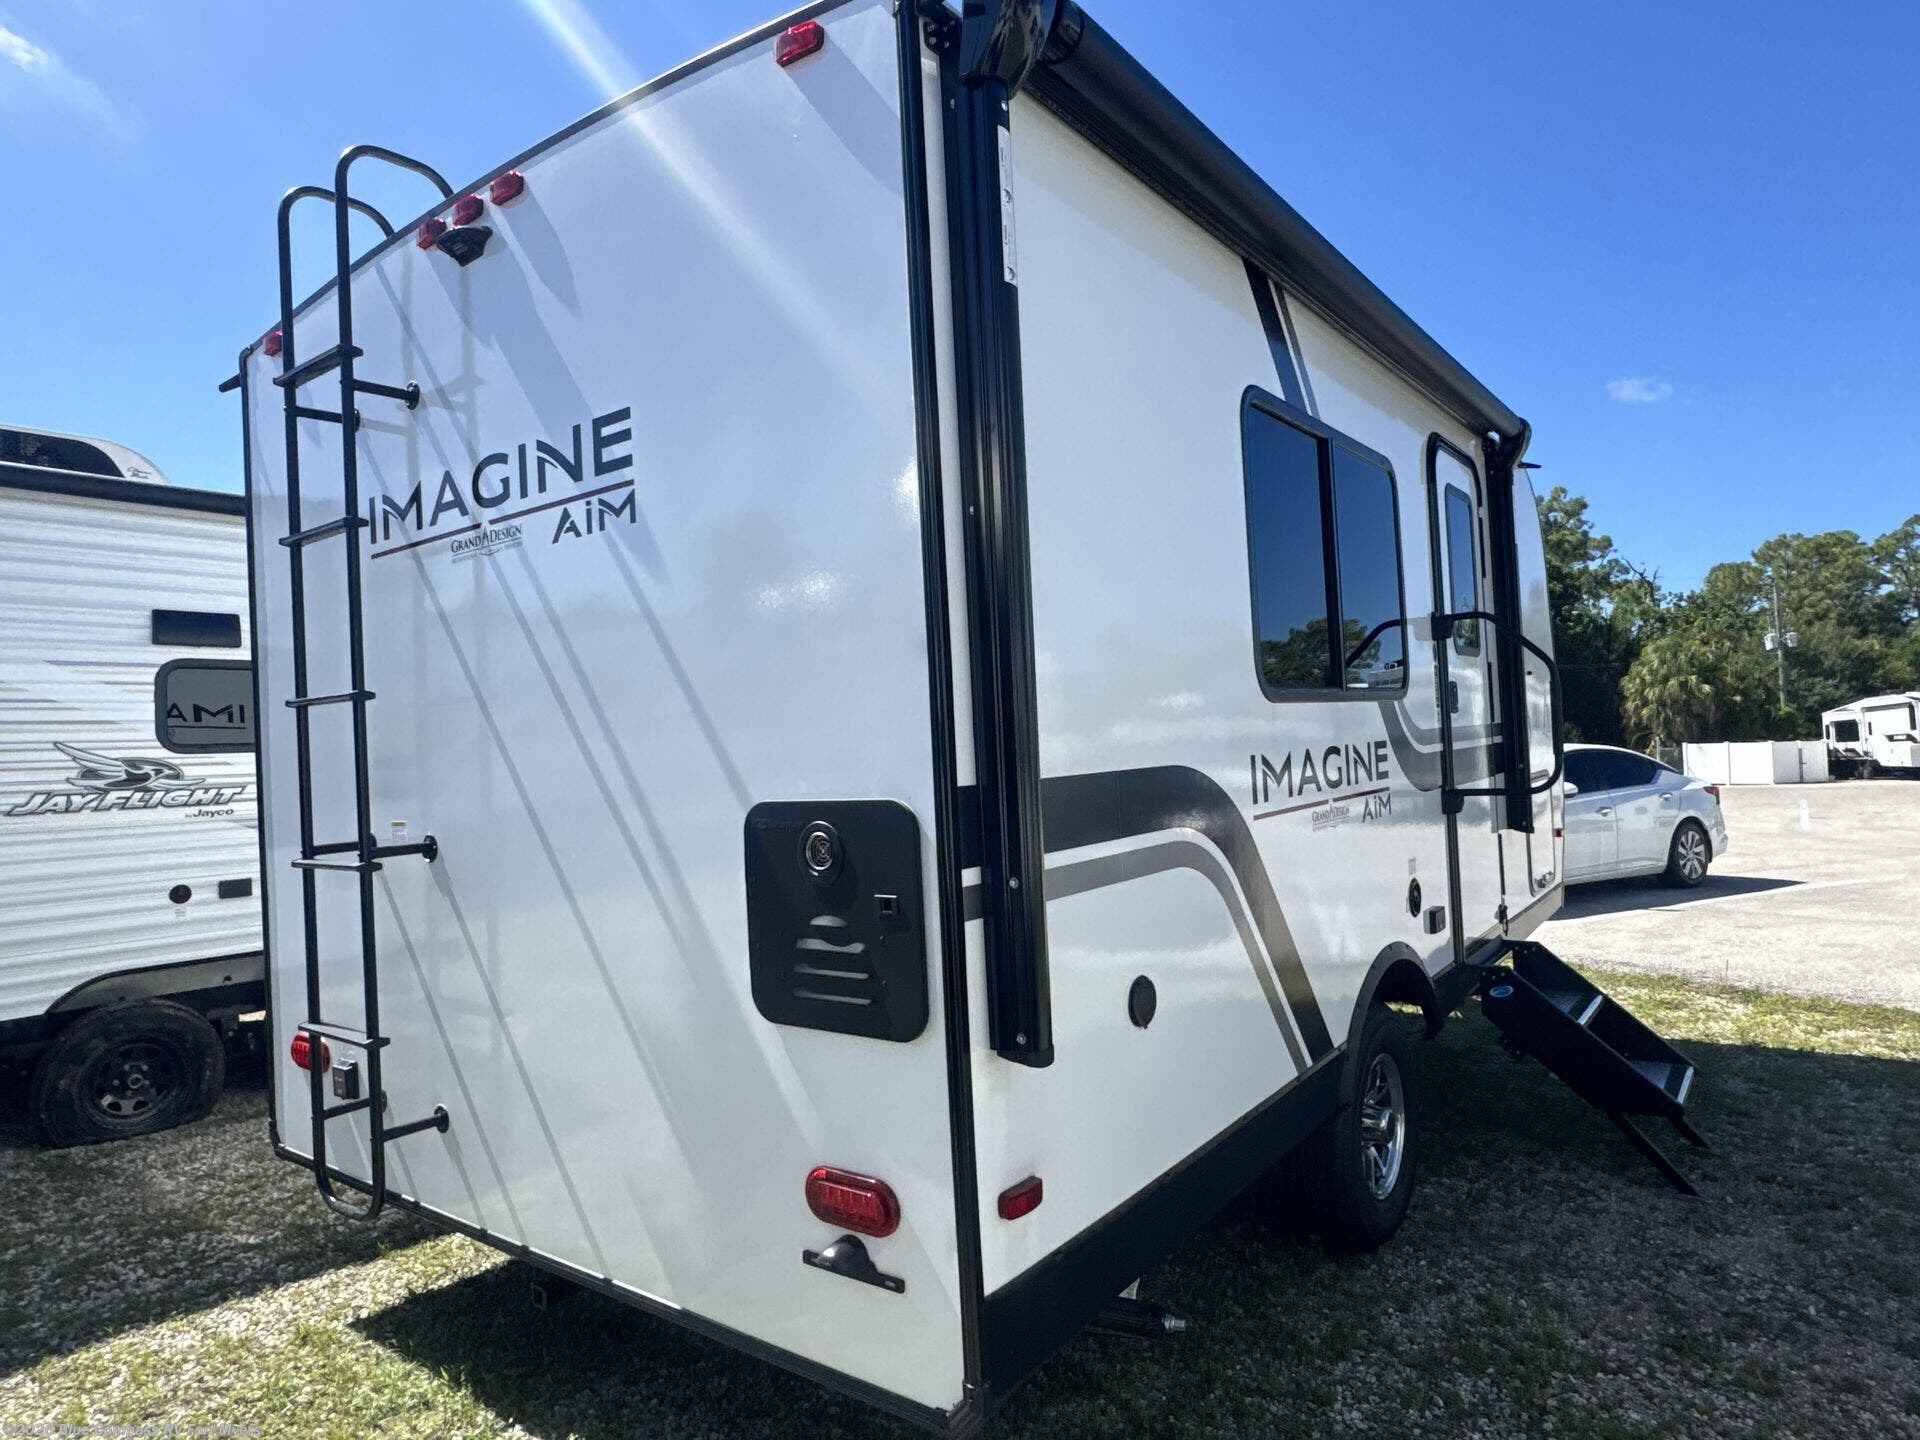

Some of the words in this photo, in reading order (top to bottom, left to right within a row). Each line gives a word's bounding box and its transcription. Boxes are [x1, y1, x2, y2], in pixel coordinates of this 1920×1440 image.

[368, 406, 634, 545] IMAGINE
[451, 535, 482, 554] GRAND
[489, 522, 523, 543] DESIGN
[1250, 740, 1390, 805] IMAGINE
[4, 790, 103, 817] JAY
[93, 784, 247, 812] FLIGHT
[192, 808, 234, 818] Jayco
